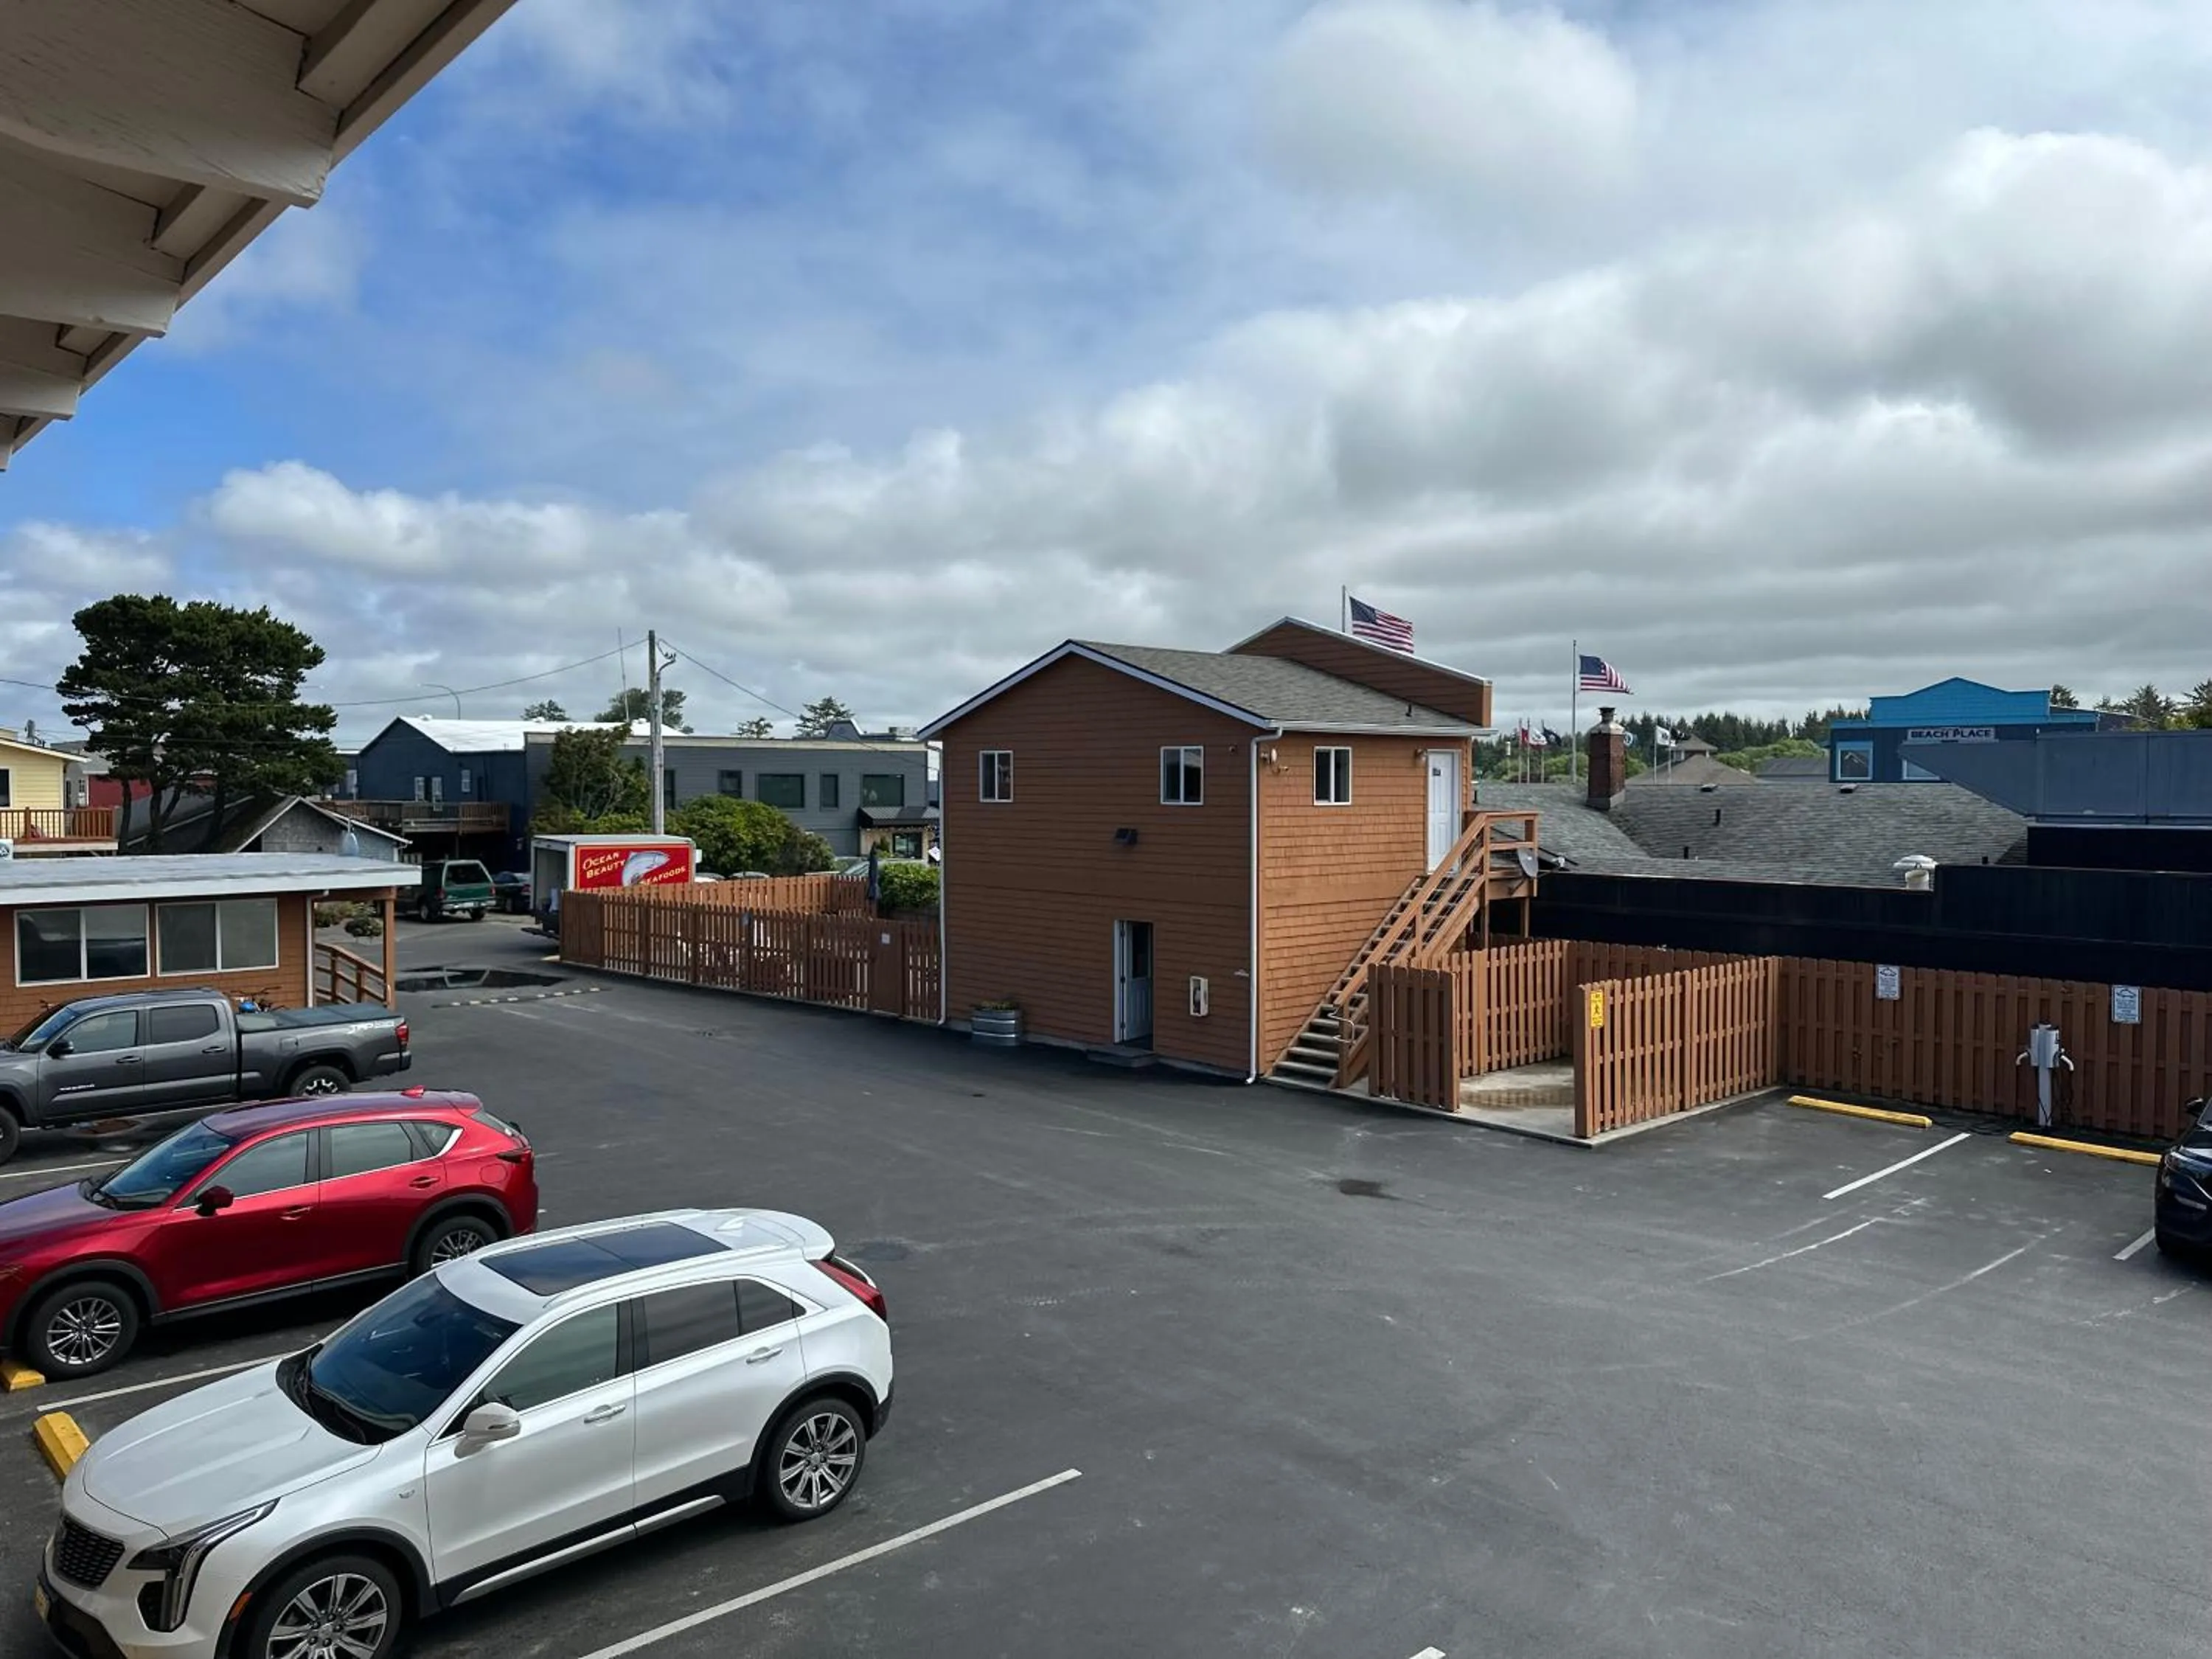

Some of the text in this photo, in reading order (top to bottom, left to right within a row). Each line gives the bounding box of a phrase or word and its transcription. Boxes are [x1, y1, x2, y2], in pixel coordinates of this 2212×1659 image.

[1910, 728, 1992, 738] BEACH PLACE
[582, 852, 619, 871] OCEAN
[586, 859, 626, 879] BEAUTY
